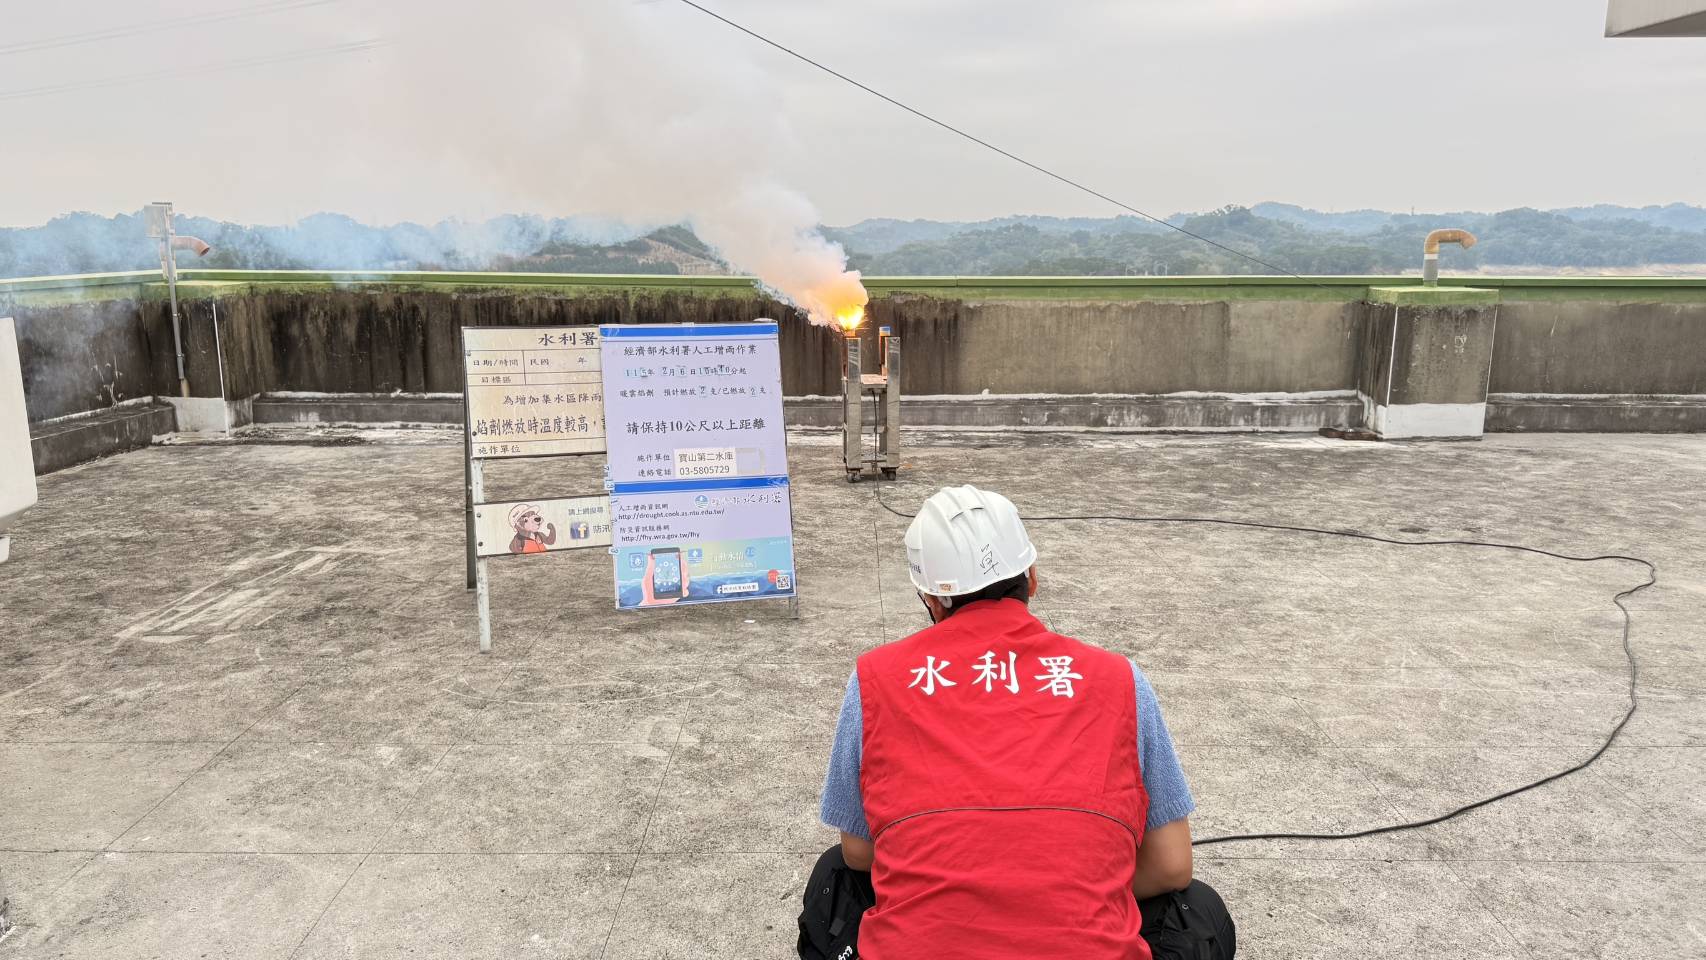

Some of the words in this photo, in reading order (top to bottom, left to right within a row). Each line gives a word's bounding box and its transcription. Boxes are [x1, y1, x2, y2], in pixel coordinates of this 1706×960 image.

[538, 332, 598, 346] 水利署
[623, 344, 757, 357] 經濟部水利署人工增雨作業
[503, 393, 602, 406] 為增加集水區降雨
[626, 417, 766, 435] 請保持10公尺以上距離
[478, 444, 521, 455] 施作單位
[637, 454, 671, 462] 施作單位
[678, 451, 734, 463] 寶山第二水庫
[679, 465, 730, 476] 03-5805729
[907, 650, 1084, 699] 水利署
